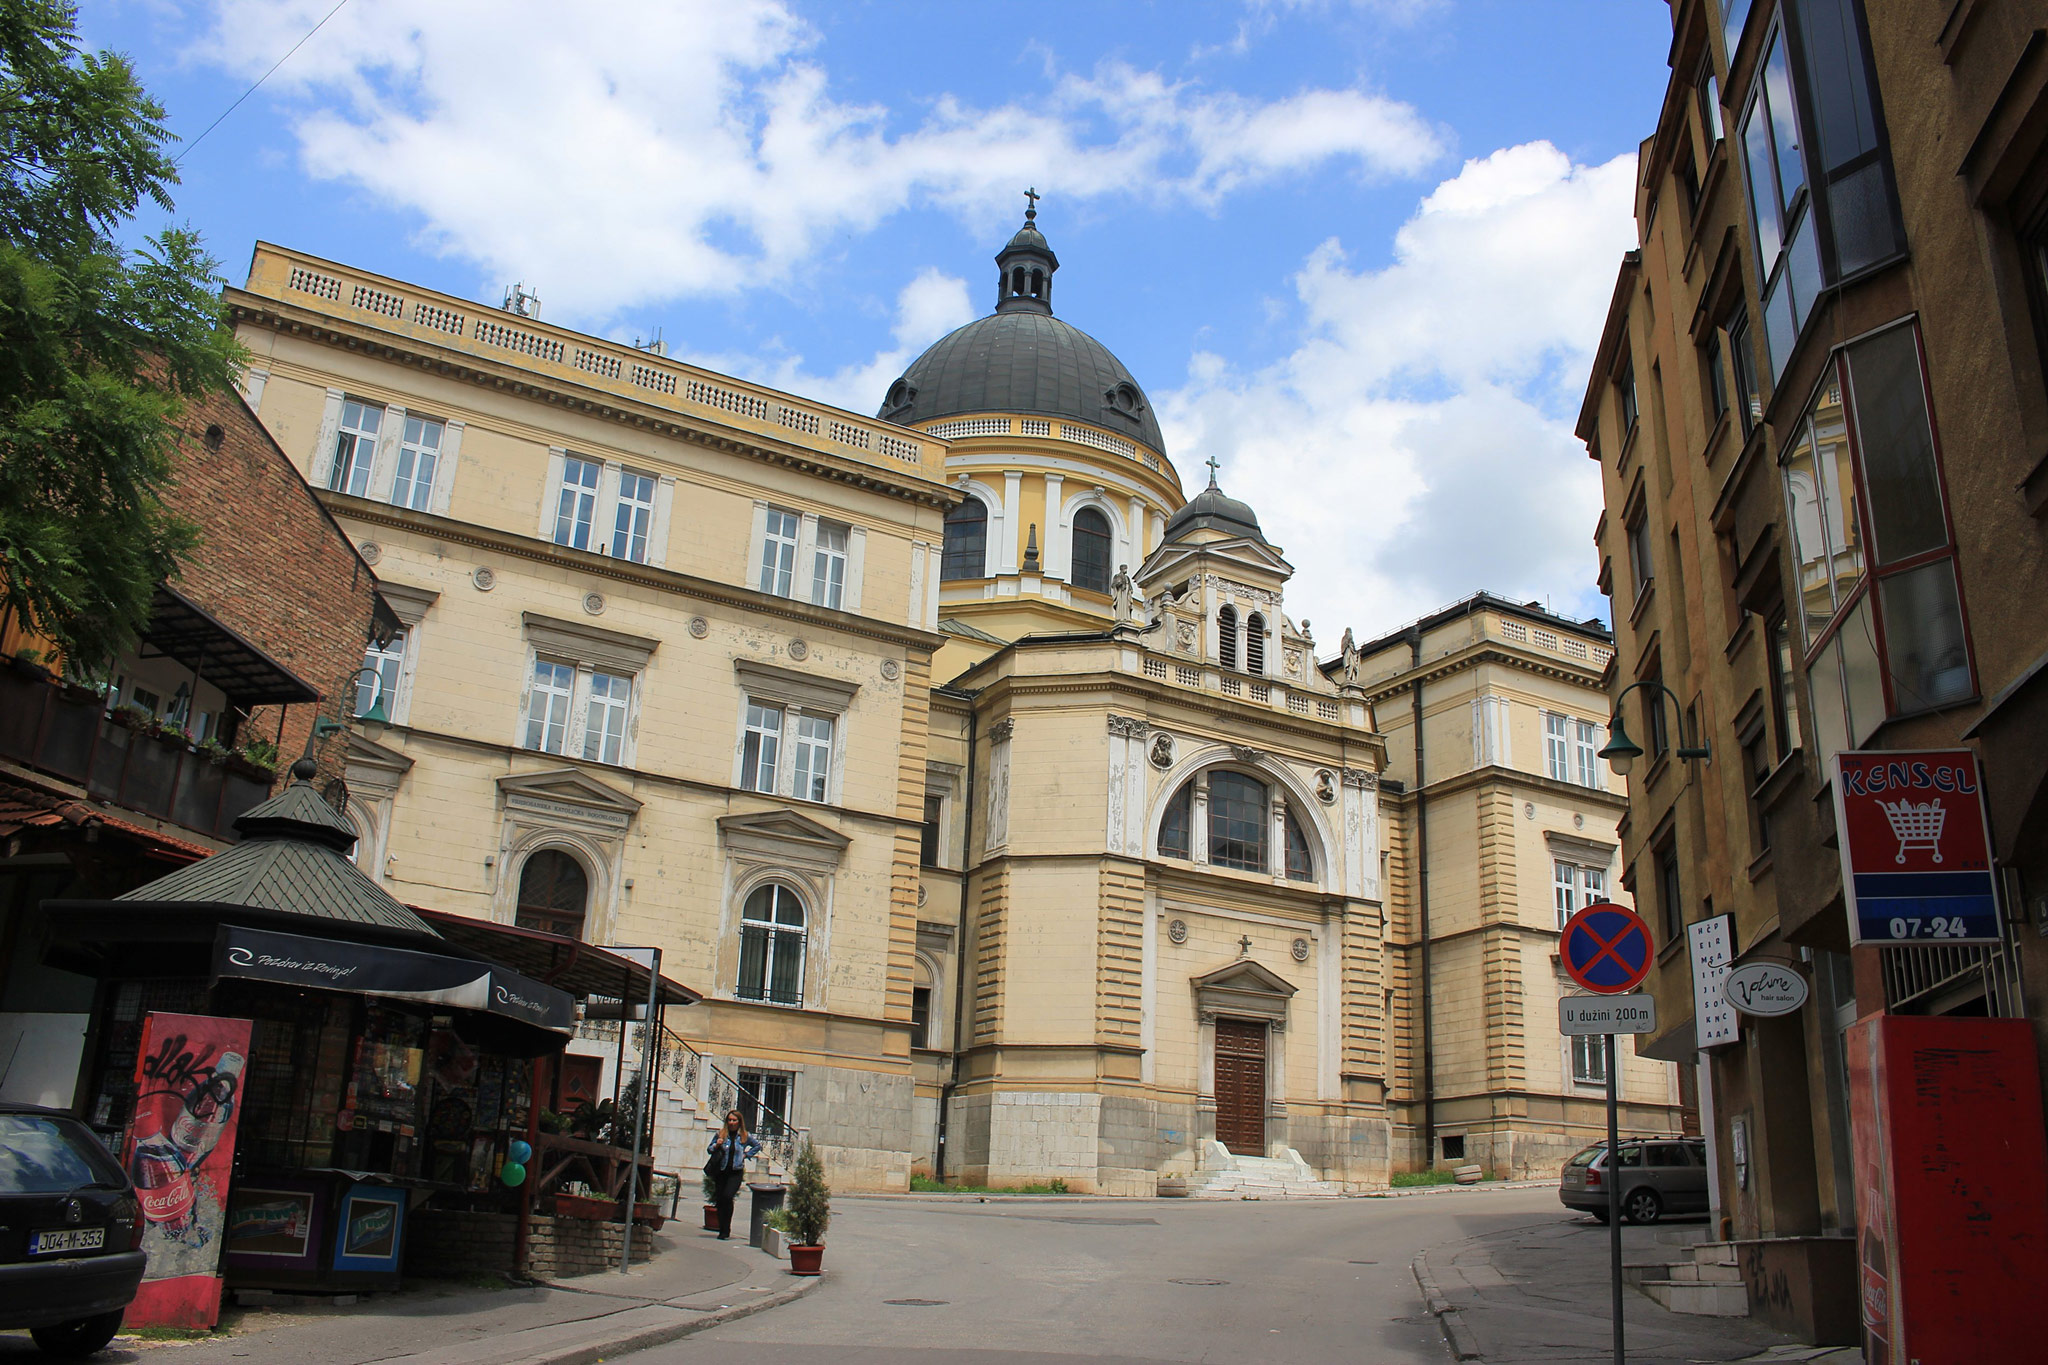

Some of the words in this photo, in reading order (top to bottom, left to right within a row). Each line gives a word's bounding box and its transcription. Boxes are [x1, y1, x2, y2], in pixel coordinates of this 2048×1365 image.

[1841, 762, 1977, 797] KENSEL
[1888, 916, 1967, 939] 07-24
[1736, 971, 1794, 1006] Volume
[1776, 994, 1795, 1002] salon
[1566, 1010, 1574, 1022] U
[1579, 1009, 1610, 1022] dužini
[1615, 1008, 1637, 1020] 200
[1639, 1010, 1649, 1020] m
